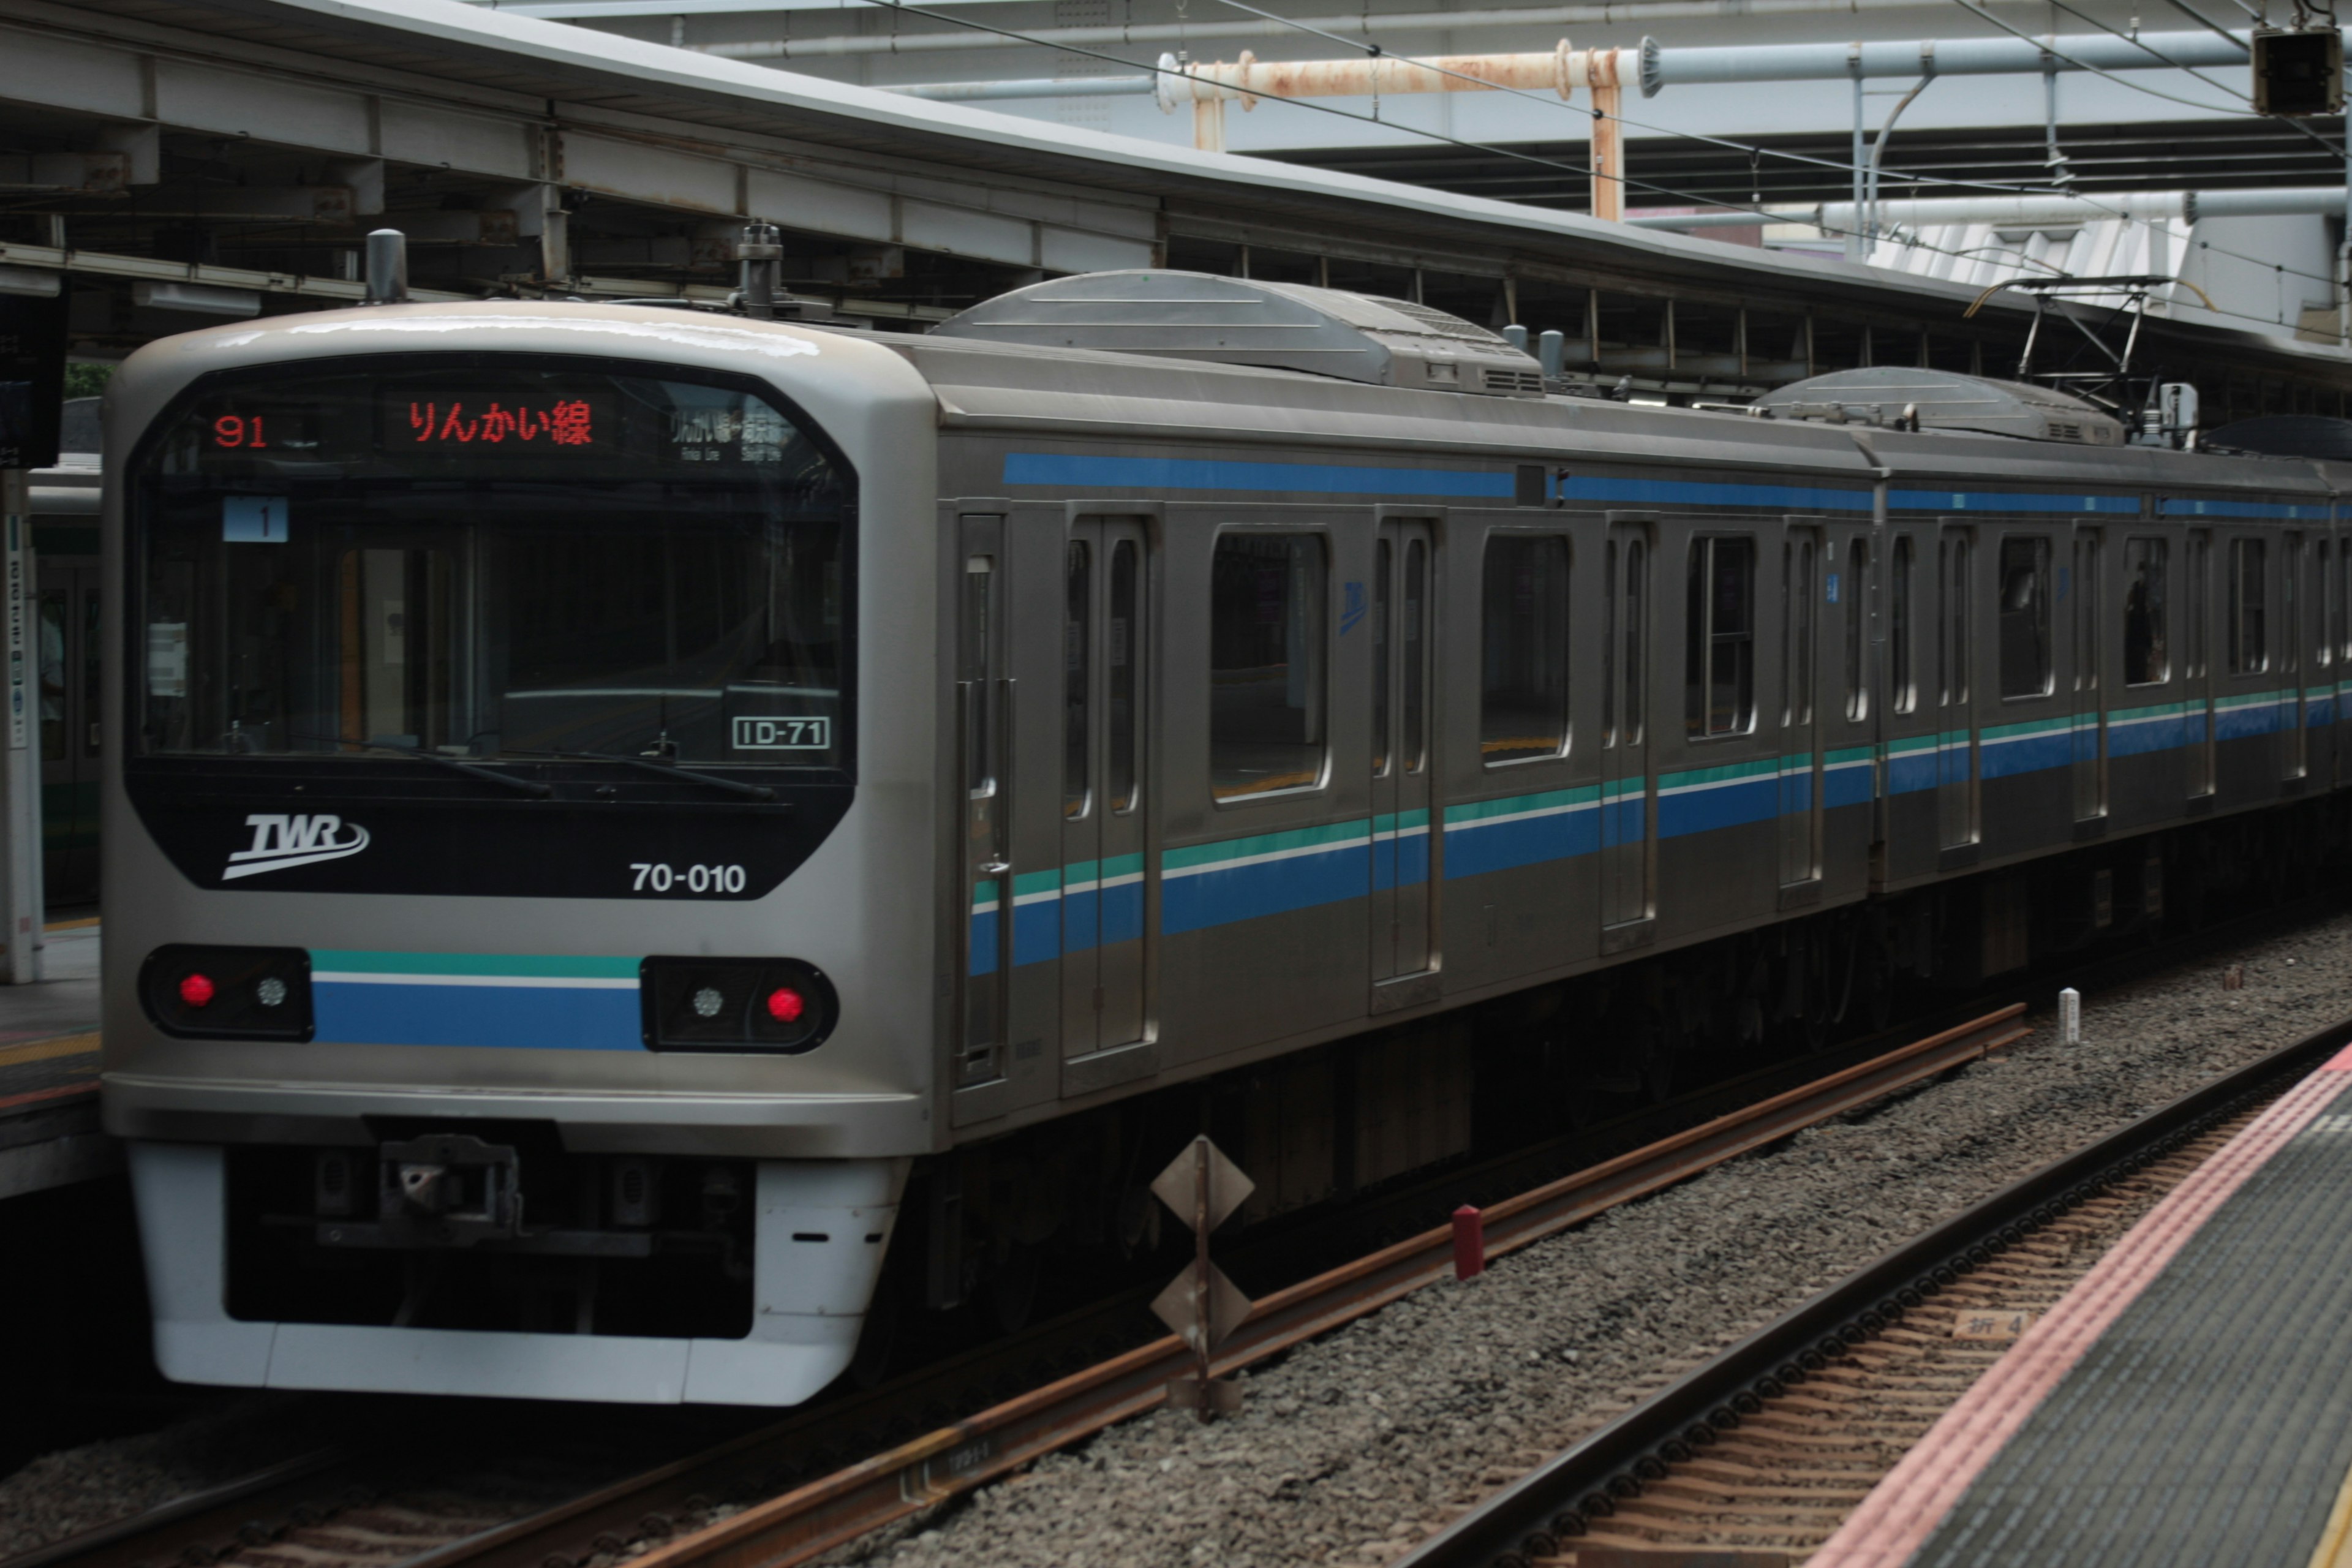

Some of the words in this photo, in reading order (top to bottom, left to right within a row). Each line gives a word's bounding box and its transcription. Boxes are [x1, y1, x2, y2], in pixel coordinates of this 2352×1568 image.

[215, 415, 268, 448] 91
[410, 401, 593, 445] りんかい線
[261, 505, 269, 537] 1
[743, 722, 821, 745] ID-71
[245, 814, 341, 852] TWR
[629, 863, 747, 893] 70-010
